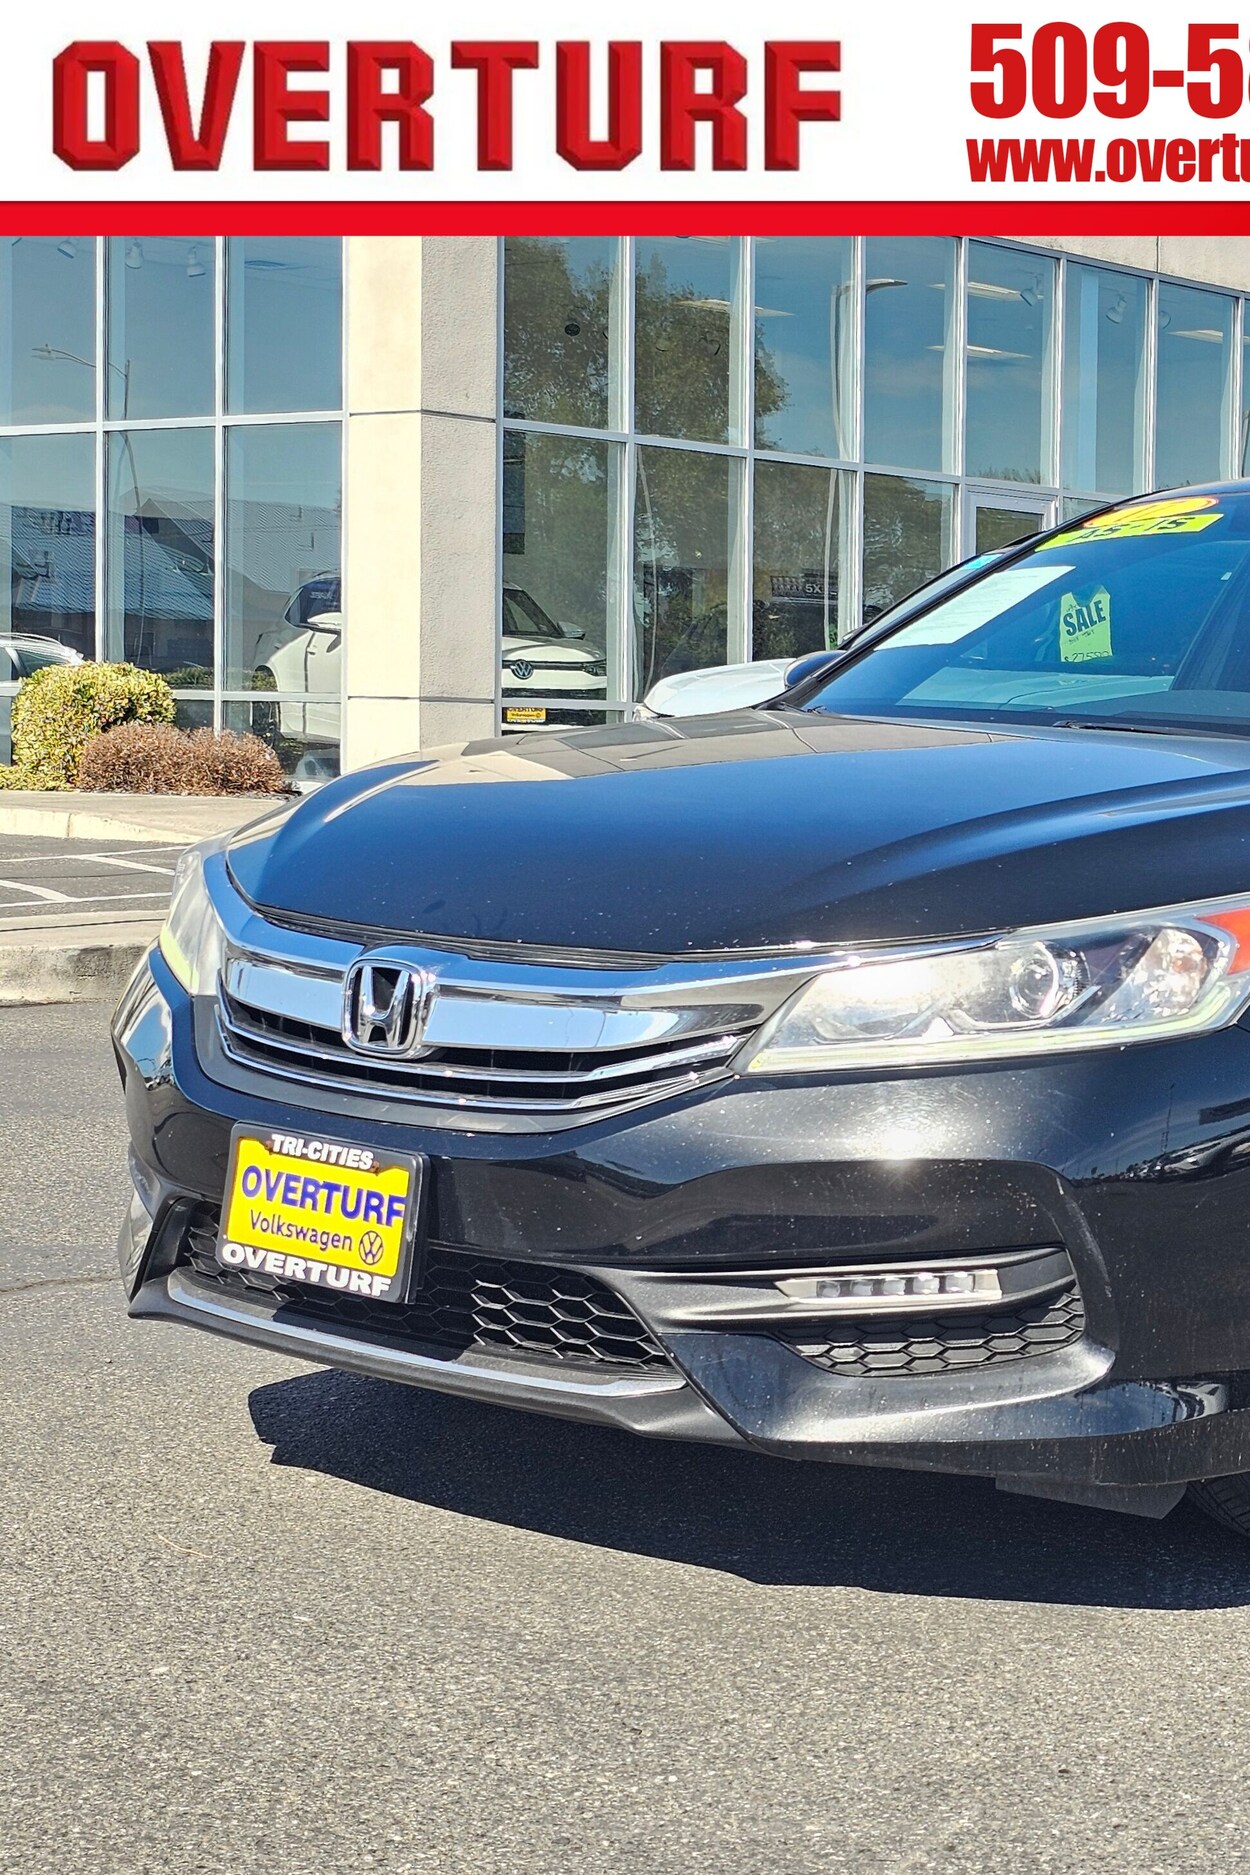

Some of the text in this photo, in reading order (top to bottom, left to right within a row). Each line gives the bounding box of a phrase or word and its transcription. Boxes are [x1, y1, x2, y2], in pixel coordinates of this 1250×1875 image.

[1063, 600, 1107, 636] SALE
[271, 1134, 375, 1170] TRI-CITIES
[241, 1165, 407, 1227] OVERTURF
[250, 1209, 354, 1252] Volkswagen
[221, 1243, 393, 1297] OVERTURF
